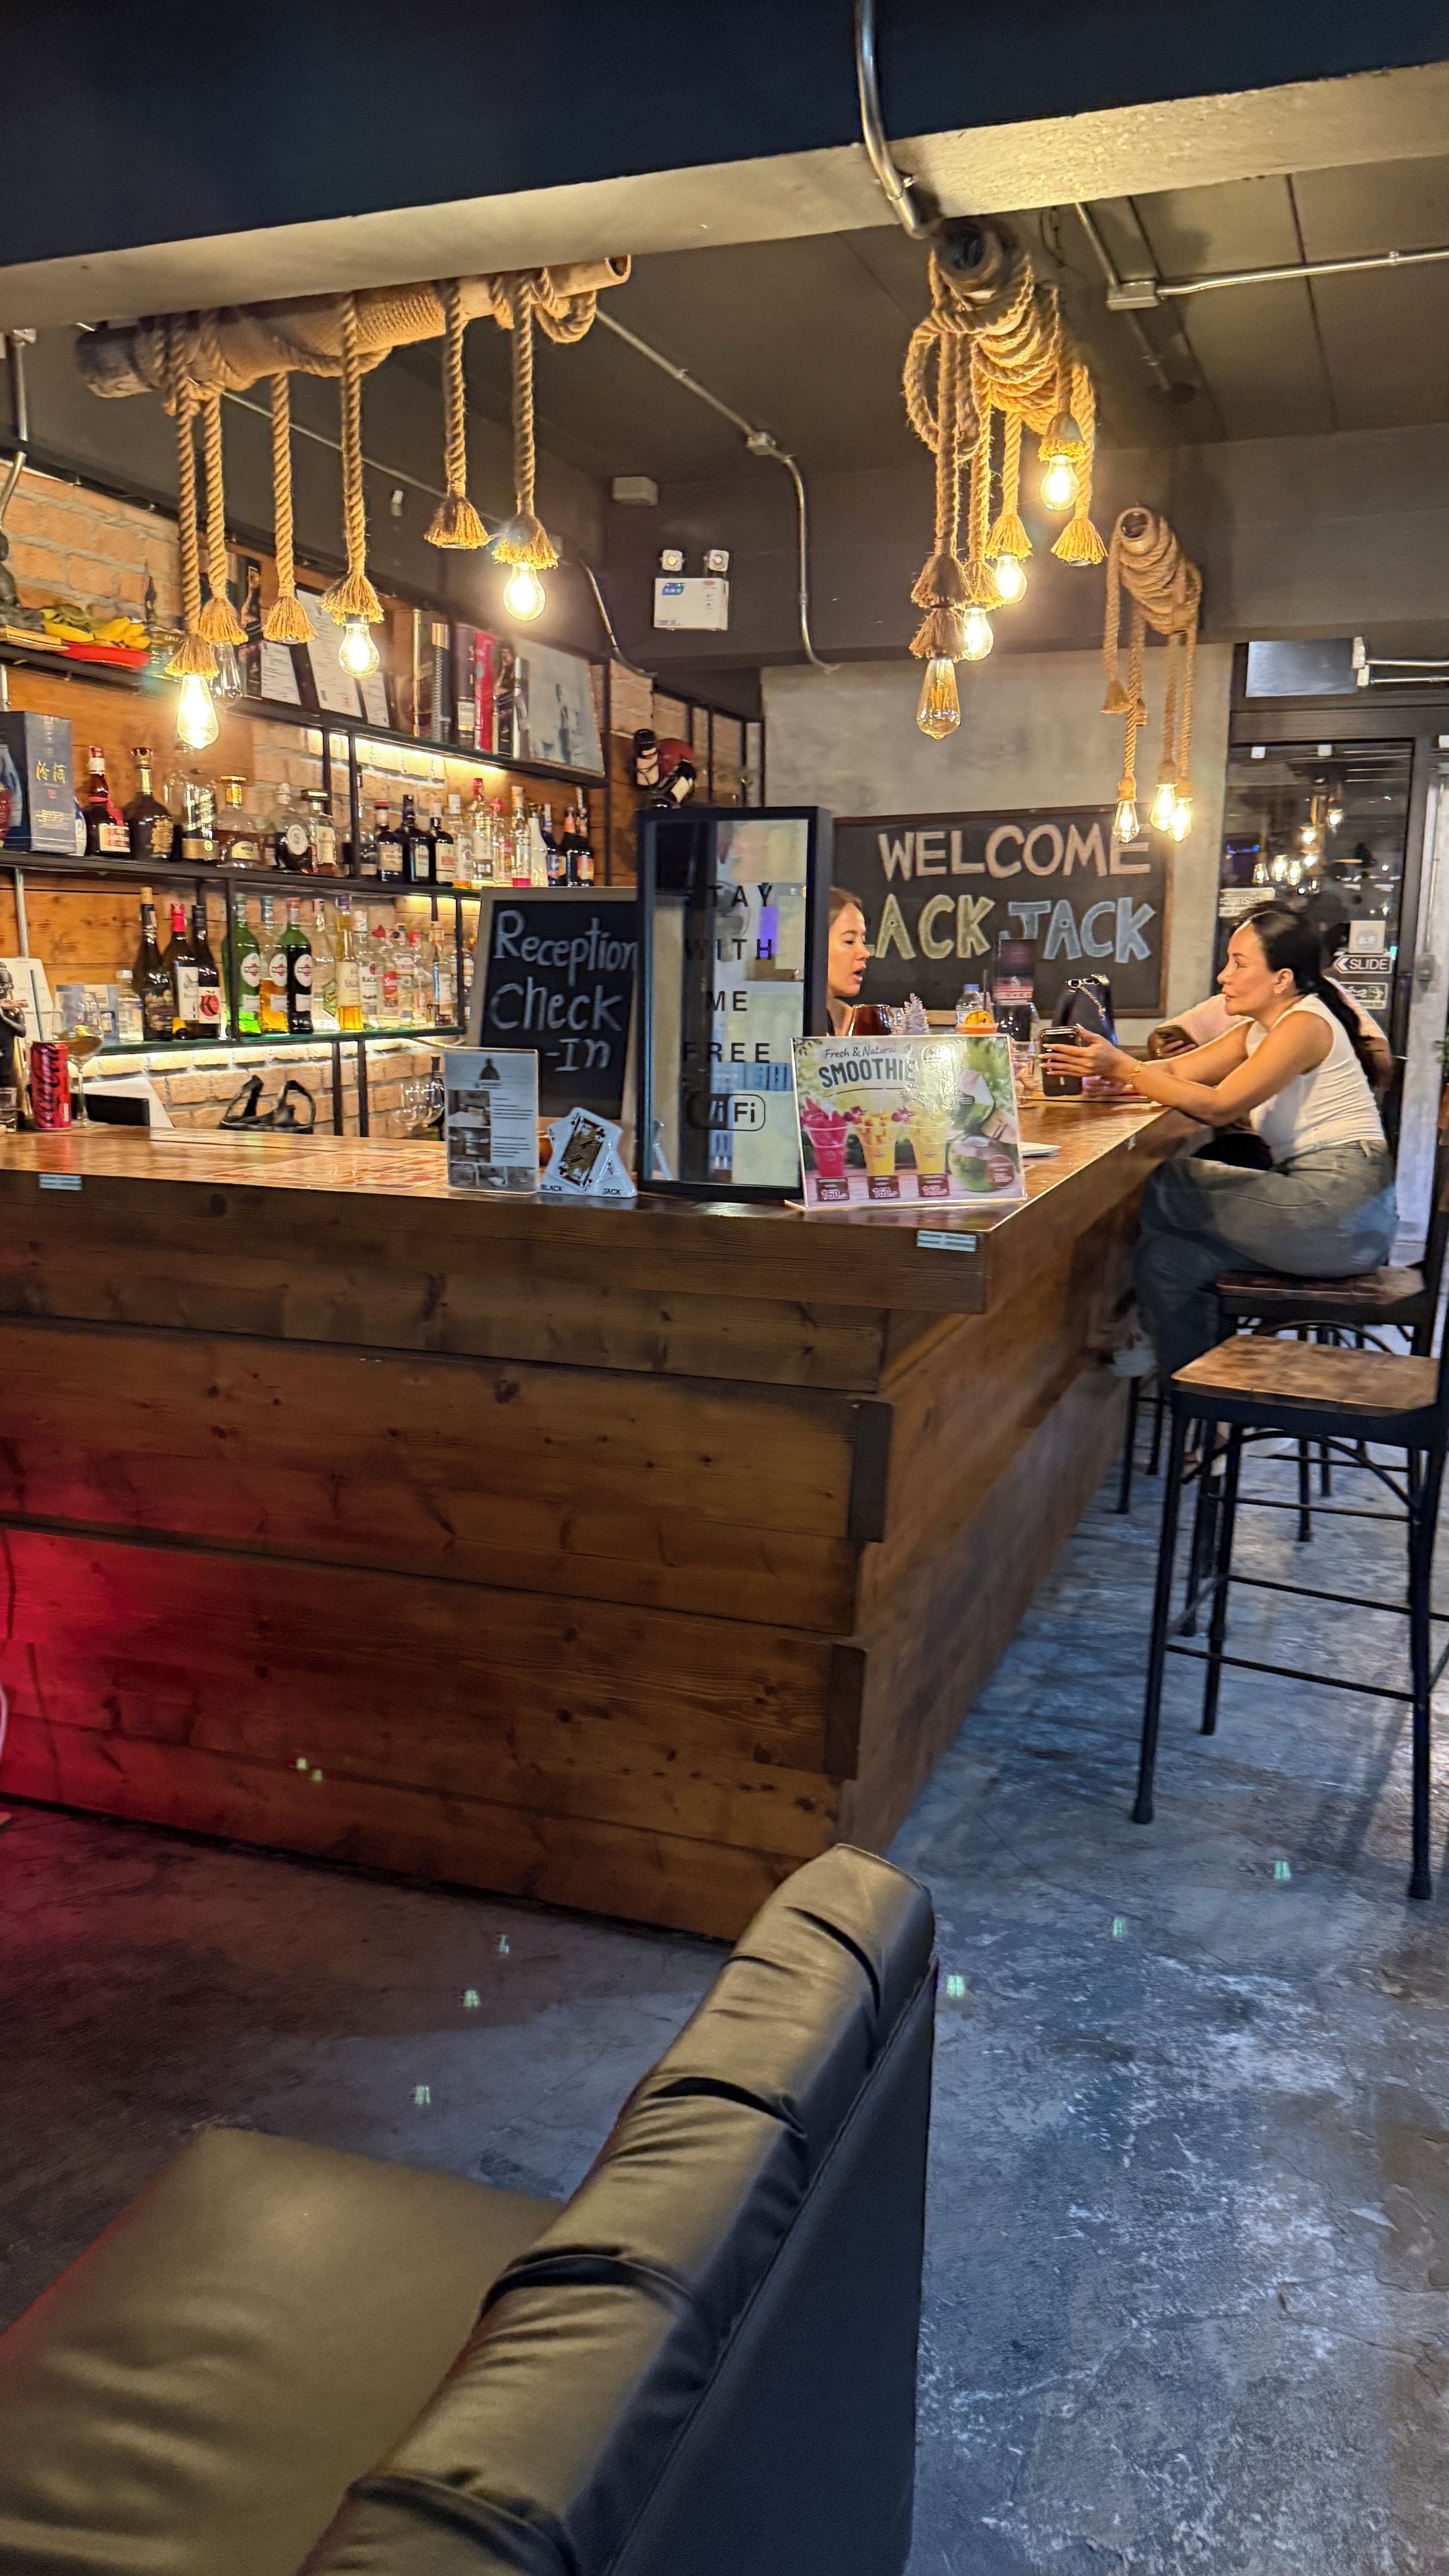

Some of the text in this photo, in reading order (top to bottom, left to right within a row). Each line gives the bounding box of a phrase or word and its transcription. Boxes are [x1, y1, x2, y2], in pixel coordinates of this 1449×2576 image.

[877, 823, 1151, 881] WELCOME
[707, 883, 773, 907] TAY
[865, 893, 1155, 963] ACK JACK
[493, 910, 639, 987] Reception
[1349, 958, 1389, 970] SLIDE
[488, 976, 623, 1031] Check
[706, 990, 747, 1012] ME
[683, 1042, 770, 1063] FREE
[824, 1048, 850, 1059] Fresh
[853, 1046, 861, 1057] &
